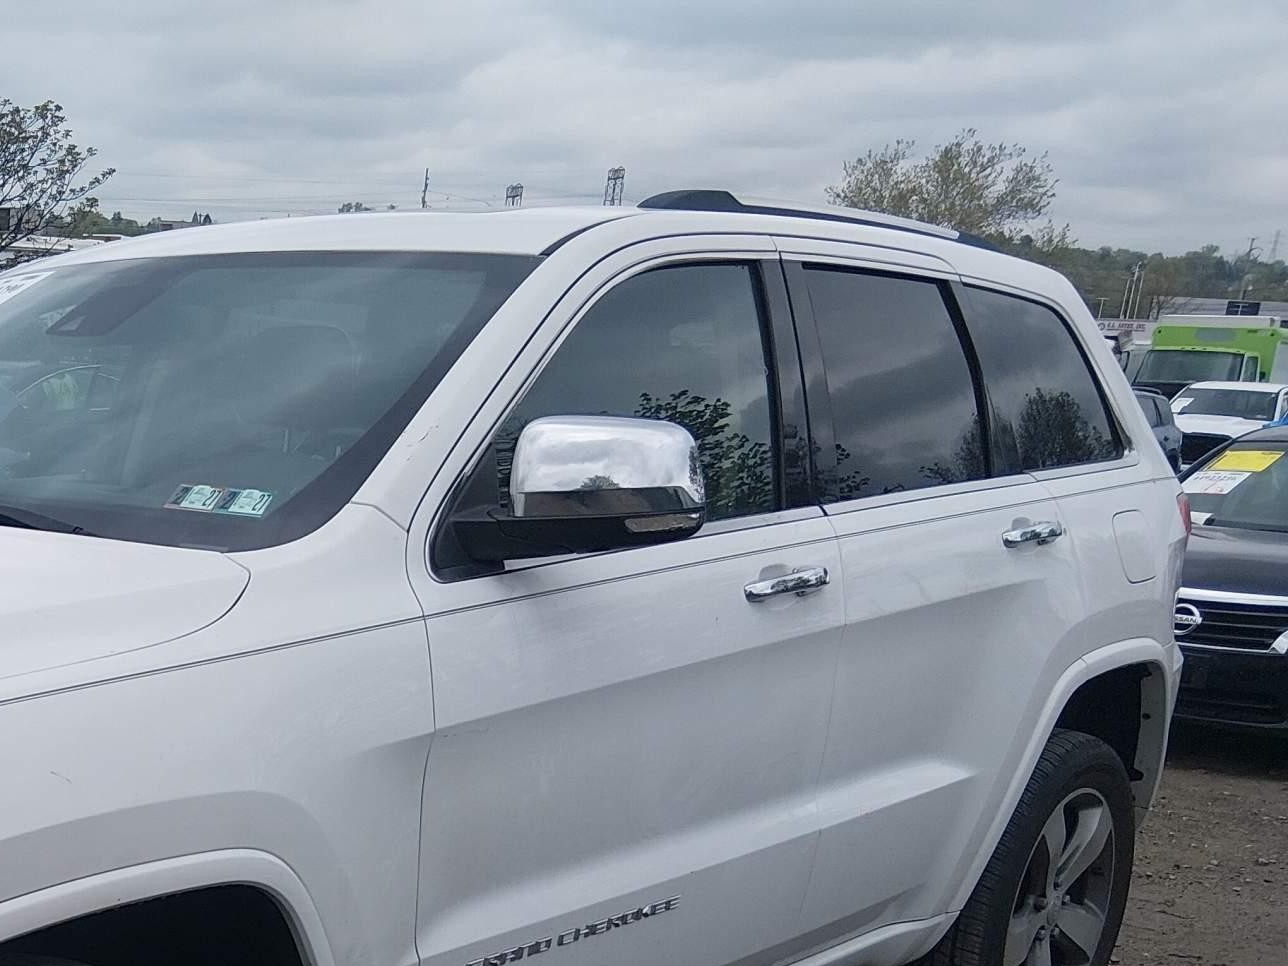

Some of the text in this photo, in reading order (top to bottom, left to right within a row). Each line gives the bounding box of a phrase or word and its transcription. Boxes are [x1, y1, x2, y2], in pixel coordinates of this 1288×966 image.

[202, 489, 221, 507] 27
[252, 493, 272, 512] 27
[556, 893, 682, 947] CHEROKEE
